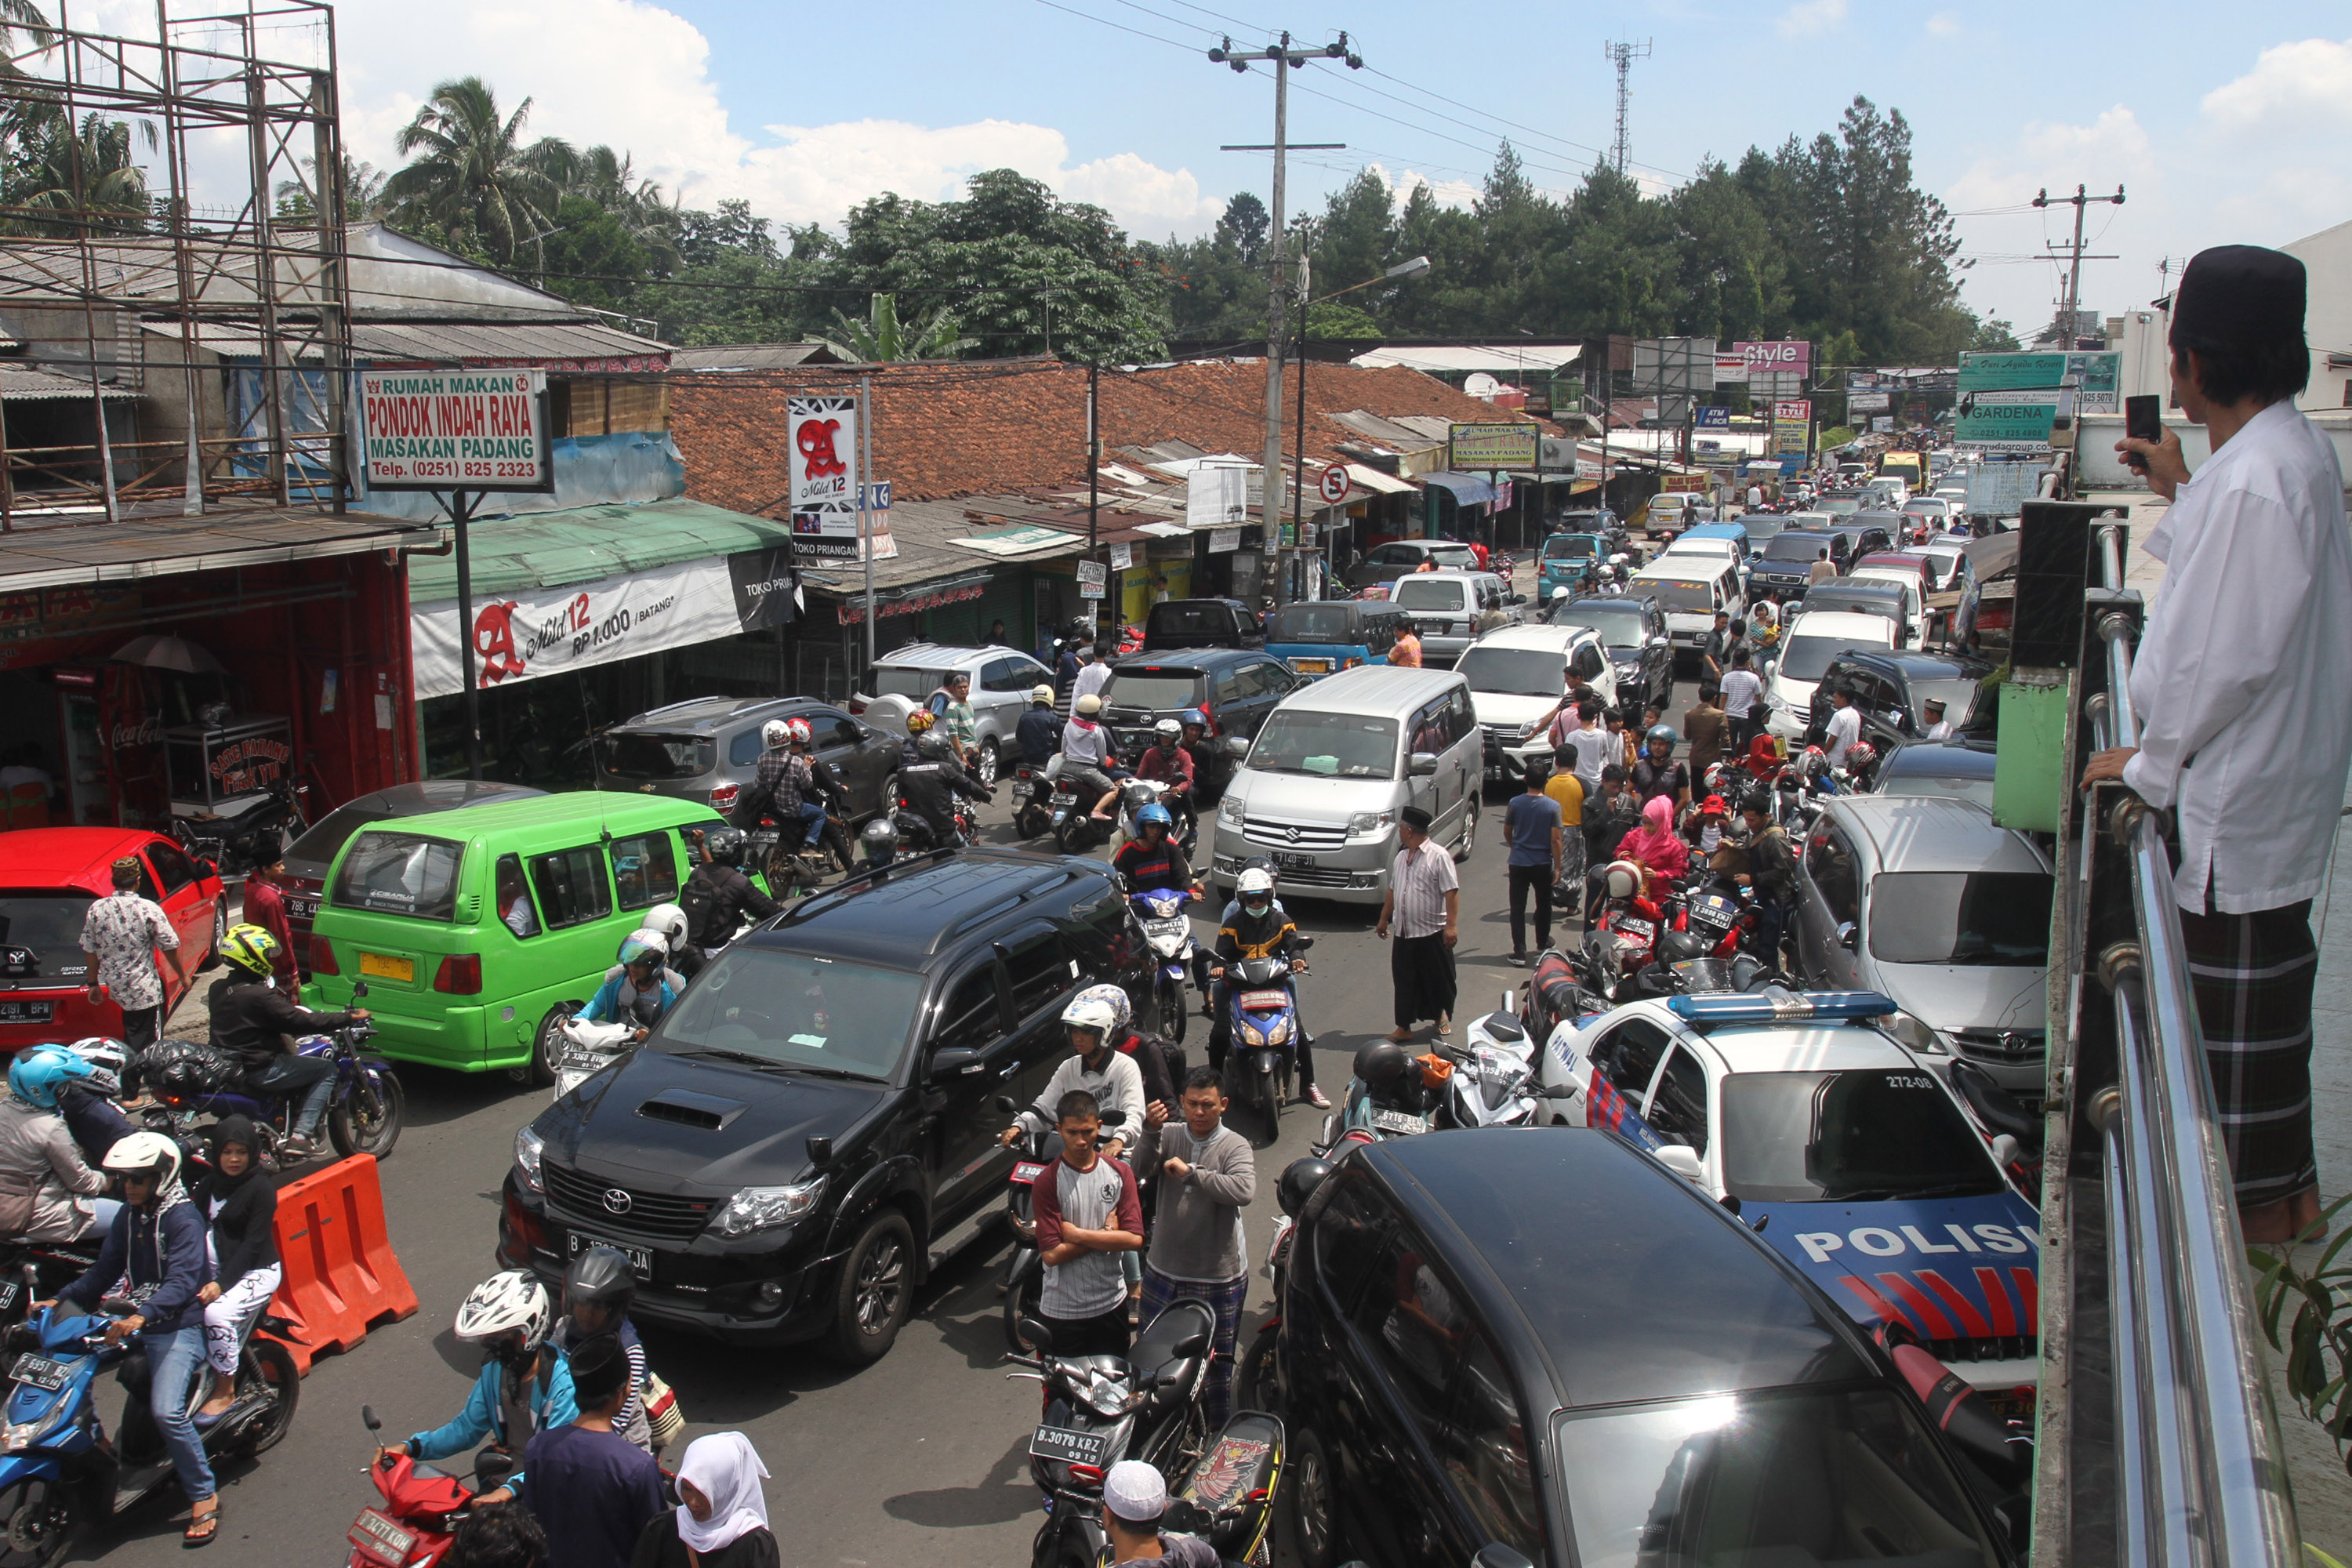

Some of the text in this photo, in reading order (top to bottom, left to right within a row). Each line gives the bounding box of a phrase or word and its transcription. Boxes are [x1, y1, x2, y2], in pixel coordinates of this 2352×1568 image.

[383, 377, 514, 394] RUMAH MAKAN
[368, 394, 532, 437] PONDOK INDAH RAYA
[1973, 408, 2042, 419] GARDENA
[370, 437, 533, 459] MASAKAN PADANG
[372, 460, 535, 478] Telp. (0251) 825 2323
[801, 477, 846, 498] Mild 12
[794, 543, 815, 554] TOKO
[746, 582, 771, 596] TOKO
[526, 610, 566, 659] Mild
[568, 593, 590, 633] 12
[572, 632, 590, 657] RP
[593, 609, 630, 647] 1.000
[291, 899, 305, 912] 786
[1550, 1034, 1579, 1073] PATWAL
[1886, 1076, 1933, 1088] 272-08
[571, 1236, 578, 1251] B
[27, 1359, 50, 1372] 6951
[367, 1515, 390, 1537] 3477
